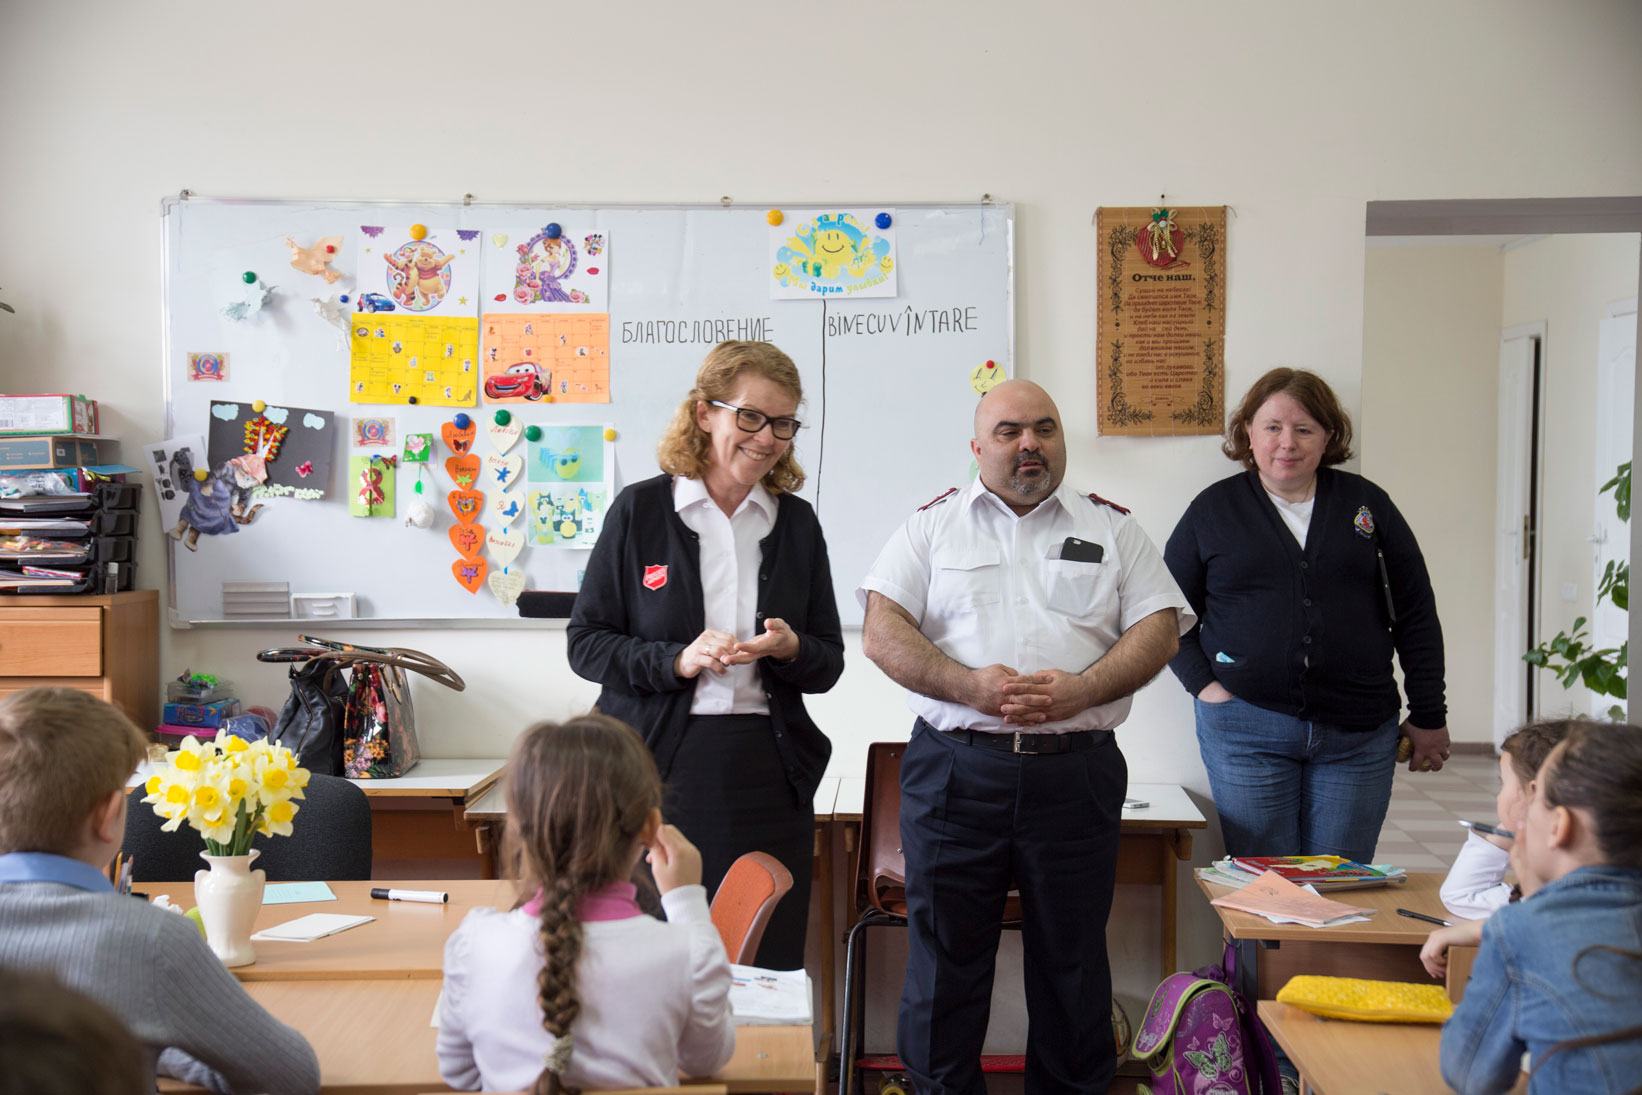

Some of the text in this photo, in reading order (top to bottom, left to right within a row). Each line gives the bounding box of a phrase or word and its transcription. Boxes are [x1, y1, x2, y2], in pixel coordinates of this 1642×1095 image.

[1132, 273, 1164, 282] Отче
[810, 281, 843, 296] дарим
[622, 317, 774, 344] БЛАГОСЛОВЕНИЕ
